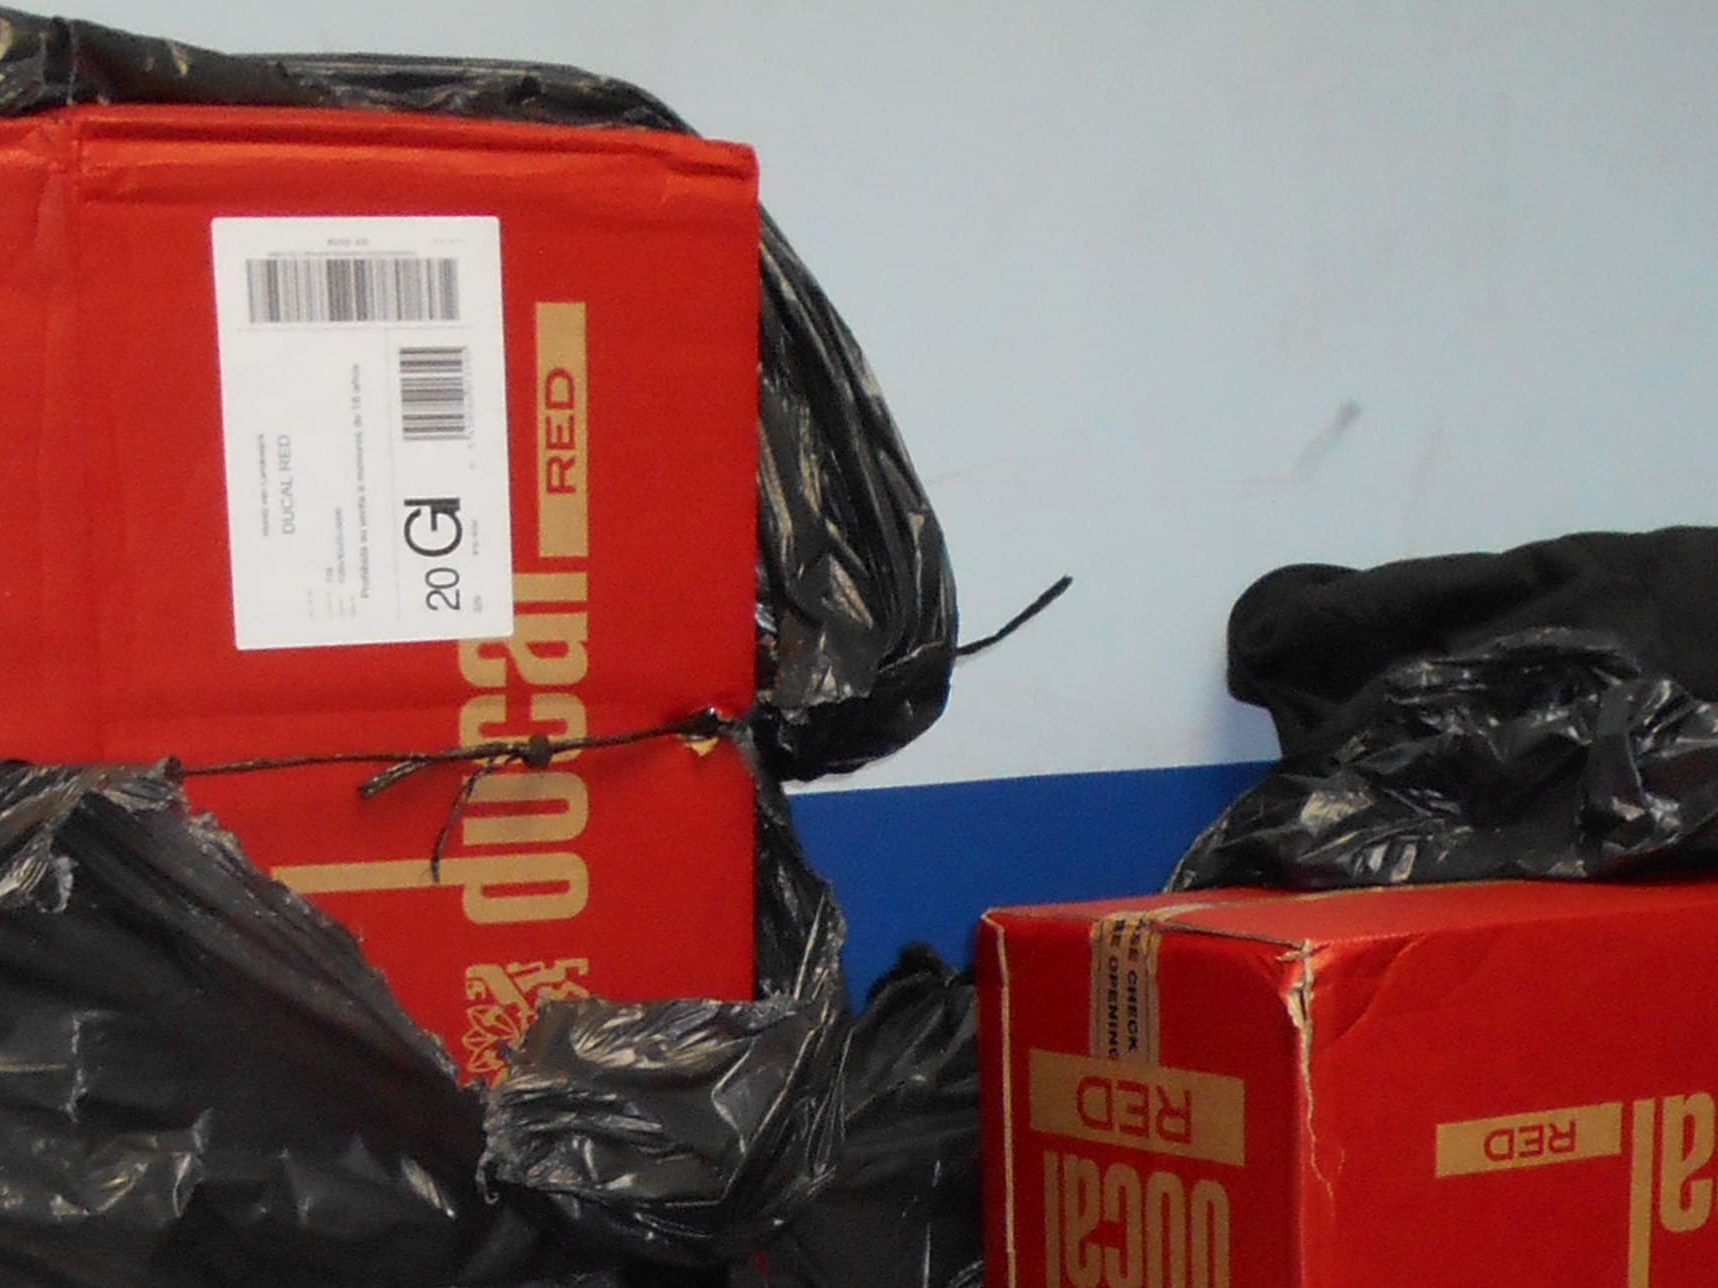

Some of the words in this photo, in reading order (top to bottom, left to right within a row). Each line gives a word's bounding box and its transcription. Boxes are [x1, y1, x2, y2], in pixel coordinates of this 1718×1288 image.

[276, 434, 292, 471] RED
[546, 368, 575, 496] RED
[280, 476, 296, 535] DUCAL
[426, 568, 461, 611] 20
[271, 572, 589, 925] duca
[1125, 970, 1140, 1053] CHECK
[1076, 1075, 1193, 1145] RED
[1484, 1117, 1576, 1162] RED
